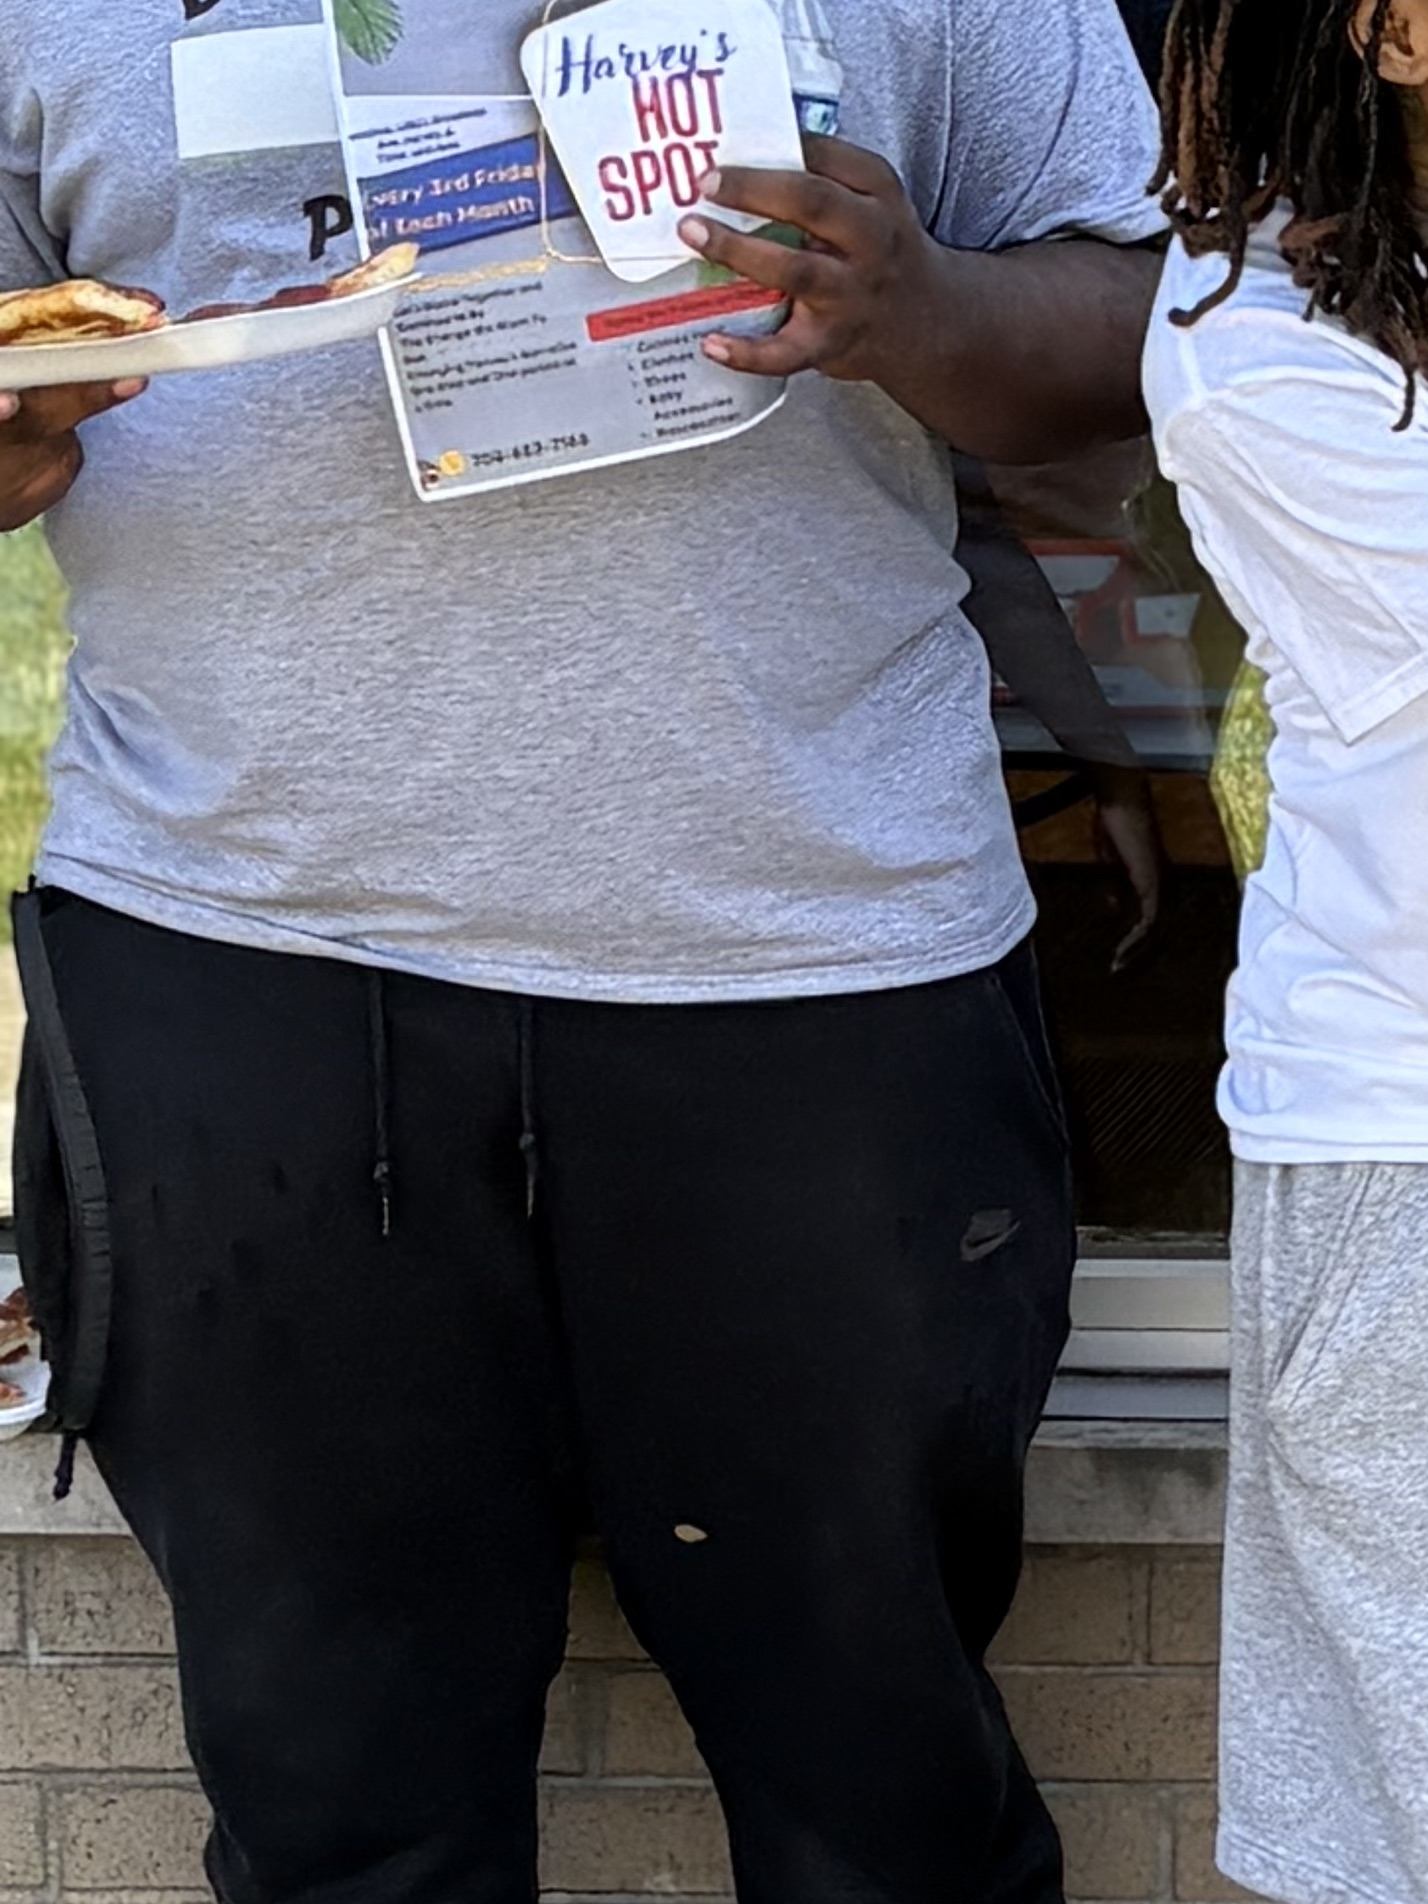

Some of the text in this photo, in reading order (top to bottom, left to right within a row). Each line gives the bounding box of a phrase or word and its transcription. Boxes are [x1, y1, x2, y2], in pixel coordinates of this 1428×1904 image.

[555, 28, 738, 97] Harvey's
[631, 68, 724, 142] HOT
[457, 194, 536, 223] Month
[474, 162, 540, 187] Frida
[597, 140, 719, 221] SPOT
